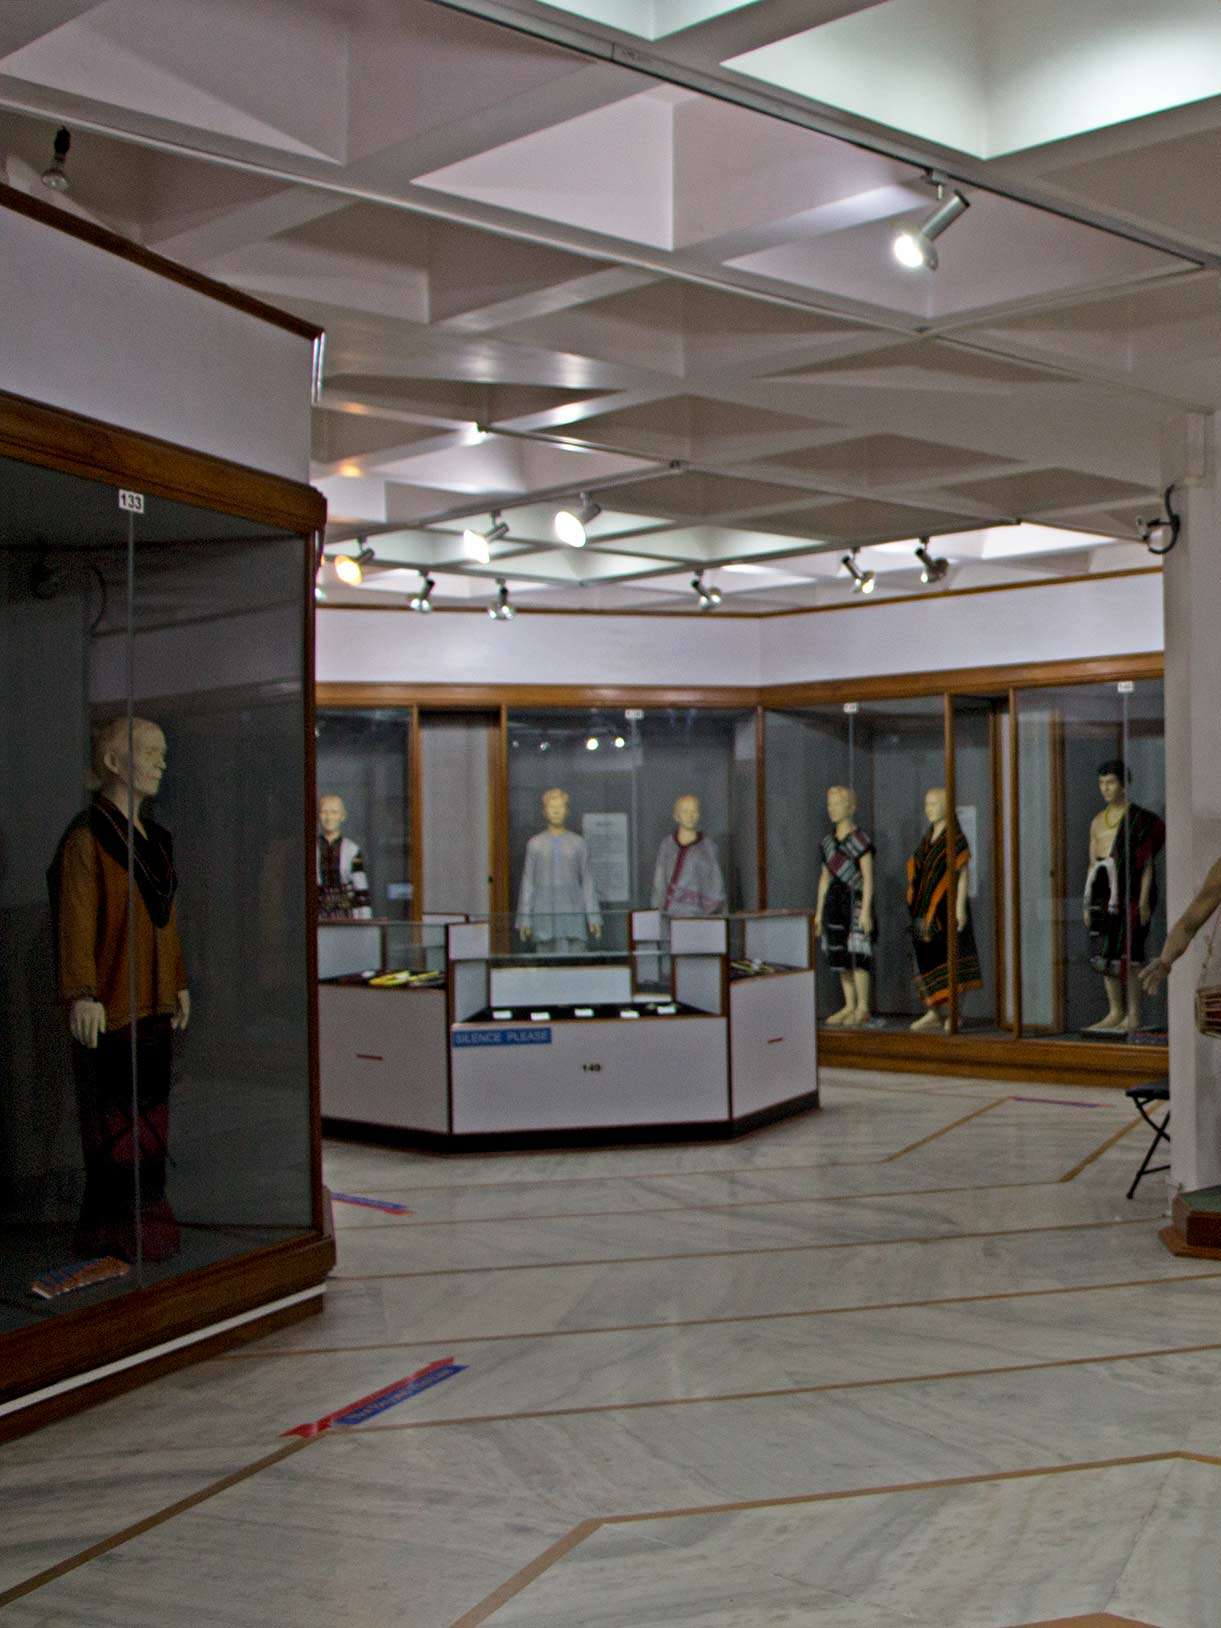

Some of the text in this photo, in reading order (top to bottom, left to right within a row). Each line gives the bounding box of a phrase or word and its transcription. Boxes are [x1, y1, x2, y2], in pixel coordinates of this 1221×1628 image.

[121, 493, 142, 510] 133
[457, 1029, 546, 1045] SILENCE PLEASE
